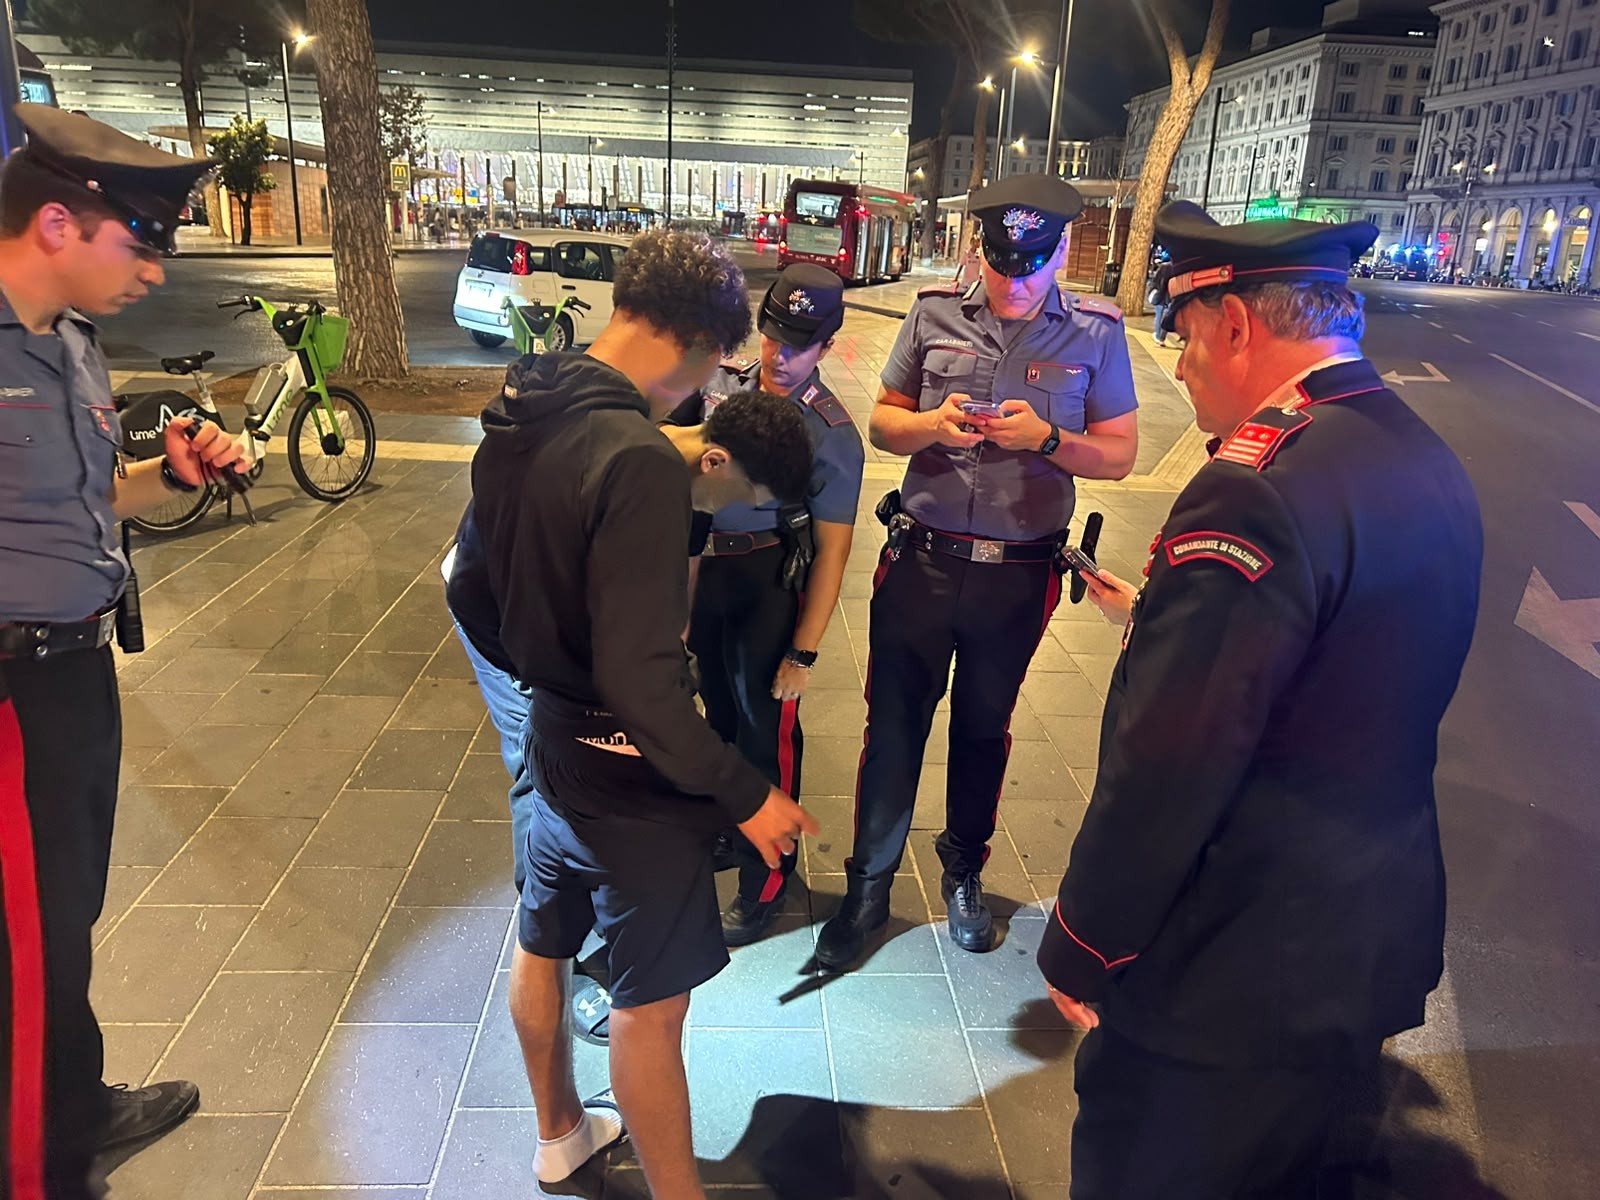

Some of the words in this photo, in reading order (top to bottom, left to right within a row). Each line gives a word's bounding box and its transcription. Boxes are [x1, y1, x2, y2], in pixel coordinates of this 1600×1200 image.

[266, 388, 294, 431] Lime
[129, 429, 157, 441] Lime
[1173, 540, 1219, 555] COMANDANTE
[1219, 541, 1229, 553] DI
[1228, 544, 1263, 571] STAZIONE
